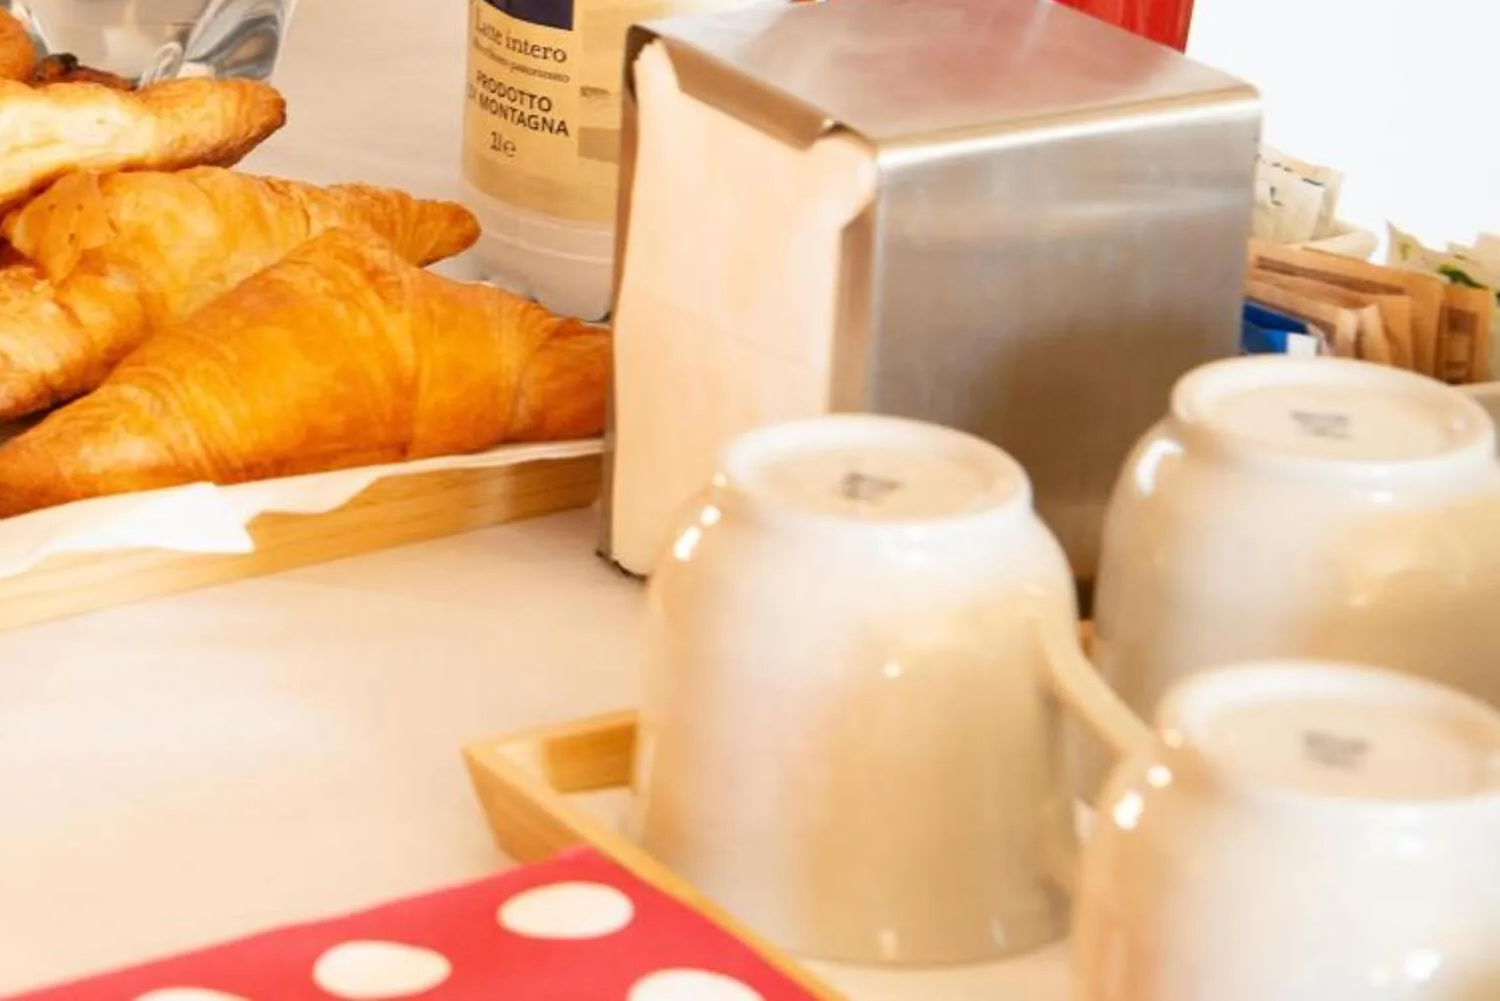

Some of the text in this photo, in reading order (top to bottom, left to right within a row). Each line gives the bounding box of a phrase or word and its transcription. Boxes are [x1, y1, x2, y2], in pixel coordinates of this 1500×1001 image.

[505, 29, 568, 64] intero
[476, 70, 553, 113] PRODOTTO
[479, 93, 570, 138] MONTAGNA
